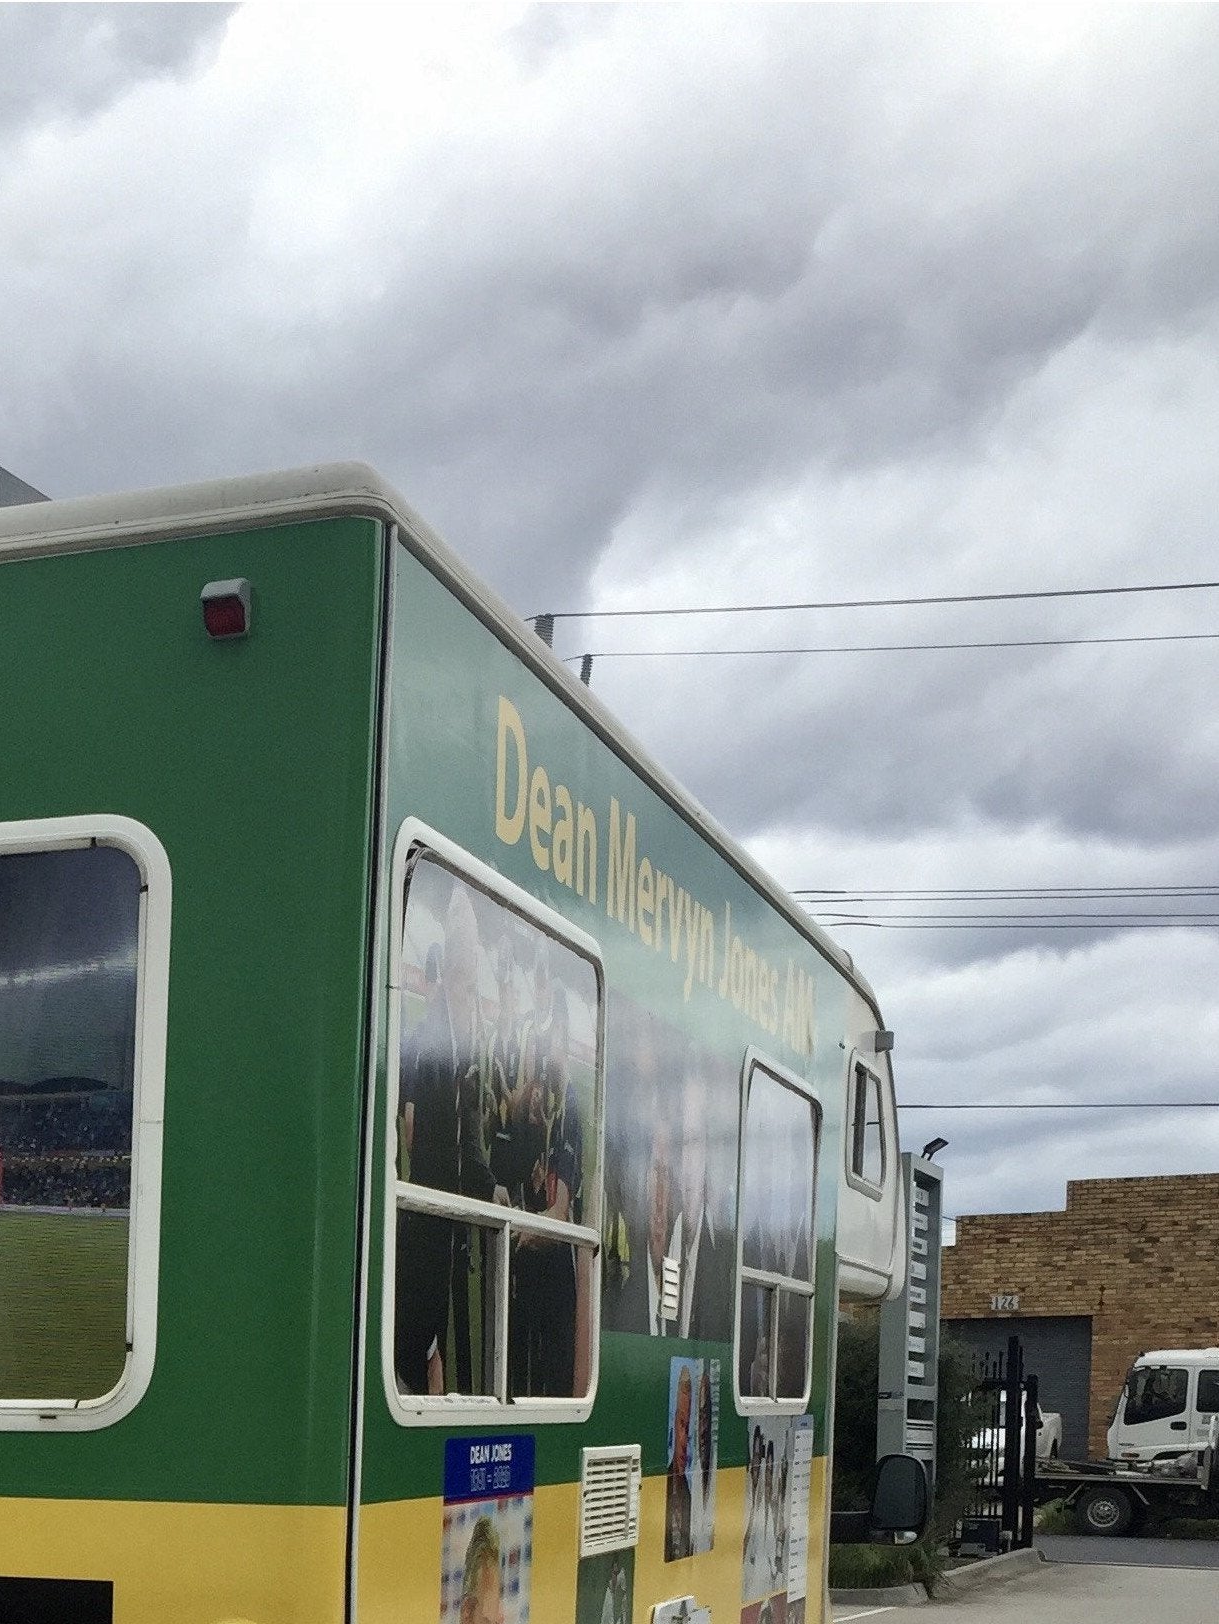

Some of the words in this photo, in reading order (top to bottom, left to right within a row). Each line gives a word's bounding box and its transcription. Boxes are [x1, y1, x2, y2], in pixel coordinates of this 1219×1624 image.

[495, 696, 597, 903] Dean
[607, 797, 715, 1001] Mervyn
[719, 899, 779, 1035] Jones
[470, 1445, 490, 1464] DEAN
[491, 1444, 512, 1462] JONES
